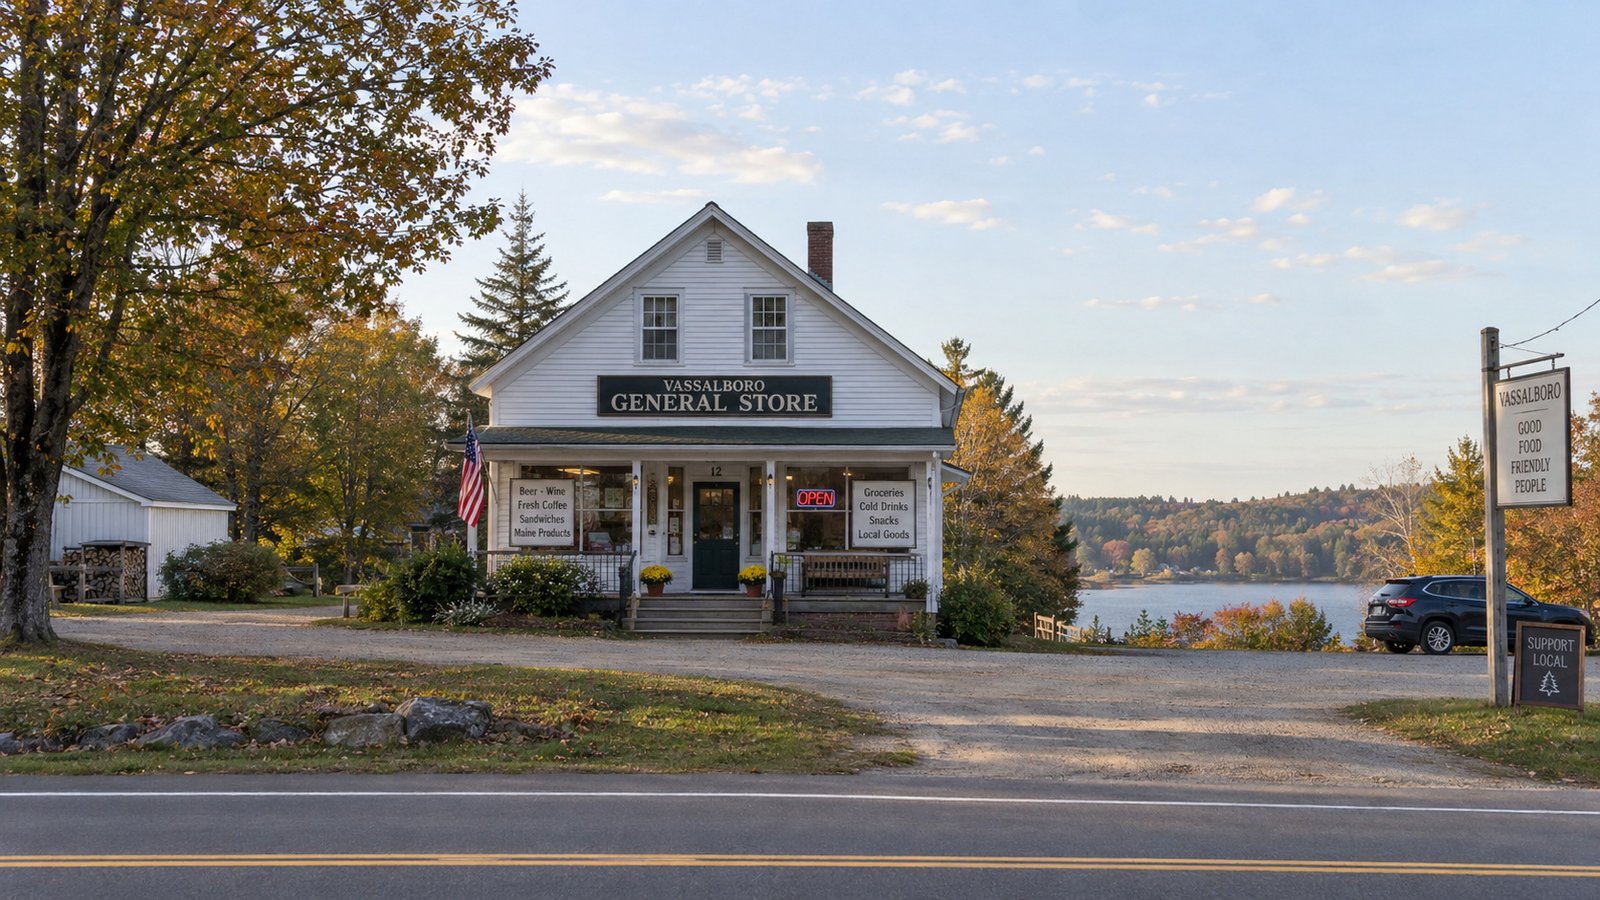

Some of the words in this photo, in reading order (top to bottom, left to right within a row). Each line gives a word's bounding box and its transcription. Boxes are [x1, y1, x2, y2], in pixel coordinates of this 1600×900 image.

[663, 380, 765, 392] VASSALBORO
[1499, 382, 1561, 407] VASSALBORO
[611, 393, 727, 412] GENERAL
[739, 393, 818, 412] STORE
[1518, 419, 1542, 435] GOOD
[1518, 438, 1542, 454] FOOD
[711, 466, 722, 477] 12
[1511, 457, 1551, 475] FRIENDLY
[519, 486, 538, 496] Beer
[546, 486, 566, 496] Wine
[1515, 478, 1547, 493] PEOPLE
[798, 491, 833, 505] OPEN
[864, 488, 904, 497] Groceries
[518, 500, 540, 510] Fresh
[542, 500, 568, 510] Coffee
[860, 502, 878, 511] Cold
[881, 502, 909, 511] Drinks
[519, 514, 565, 524] Sandwiches
[869, 516, 899, 525] Snacks
[514, 527, 537, 538] Maine
[538, 527, 571, 538] Products
[858, 530, 881, 539] Local
[883, 530, 910, 539] Goods
[1528, 637, 1574, 652] SUPPORT
[1533, 653, 1567, 668] LOCAL
